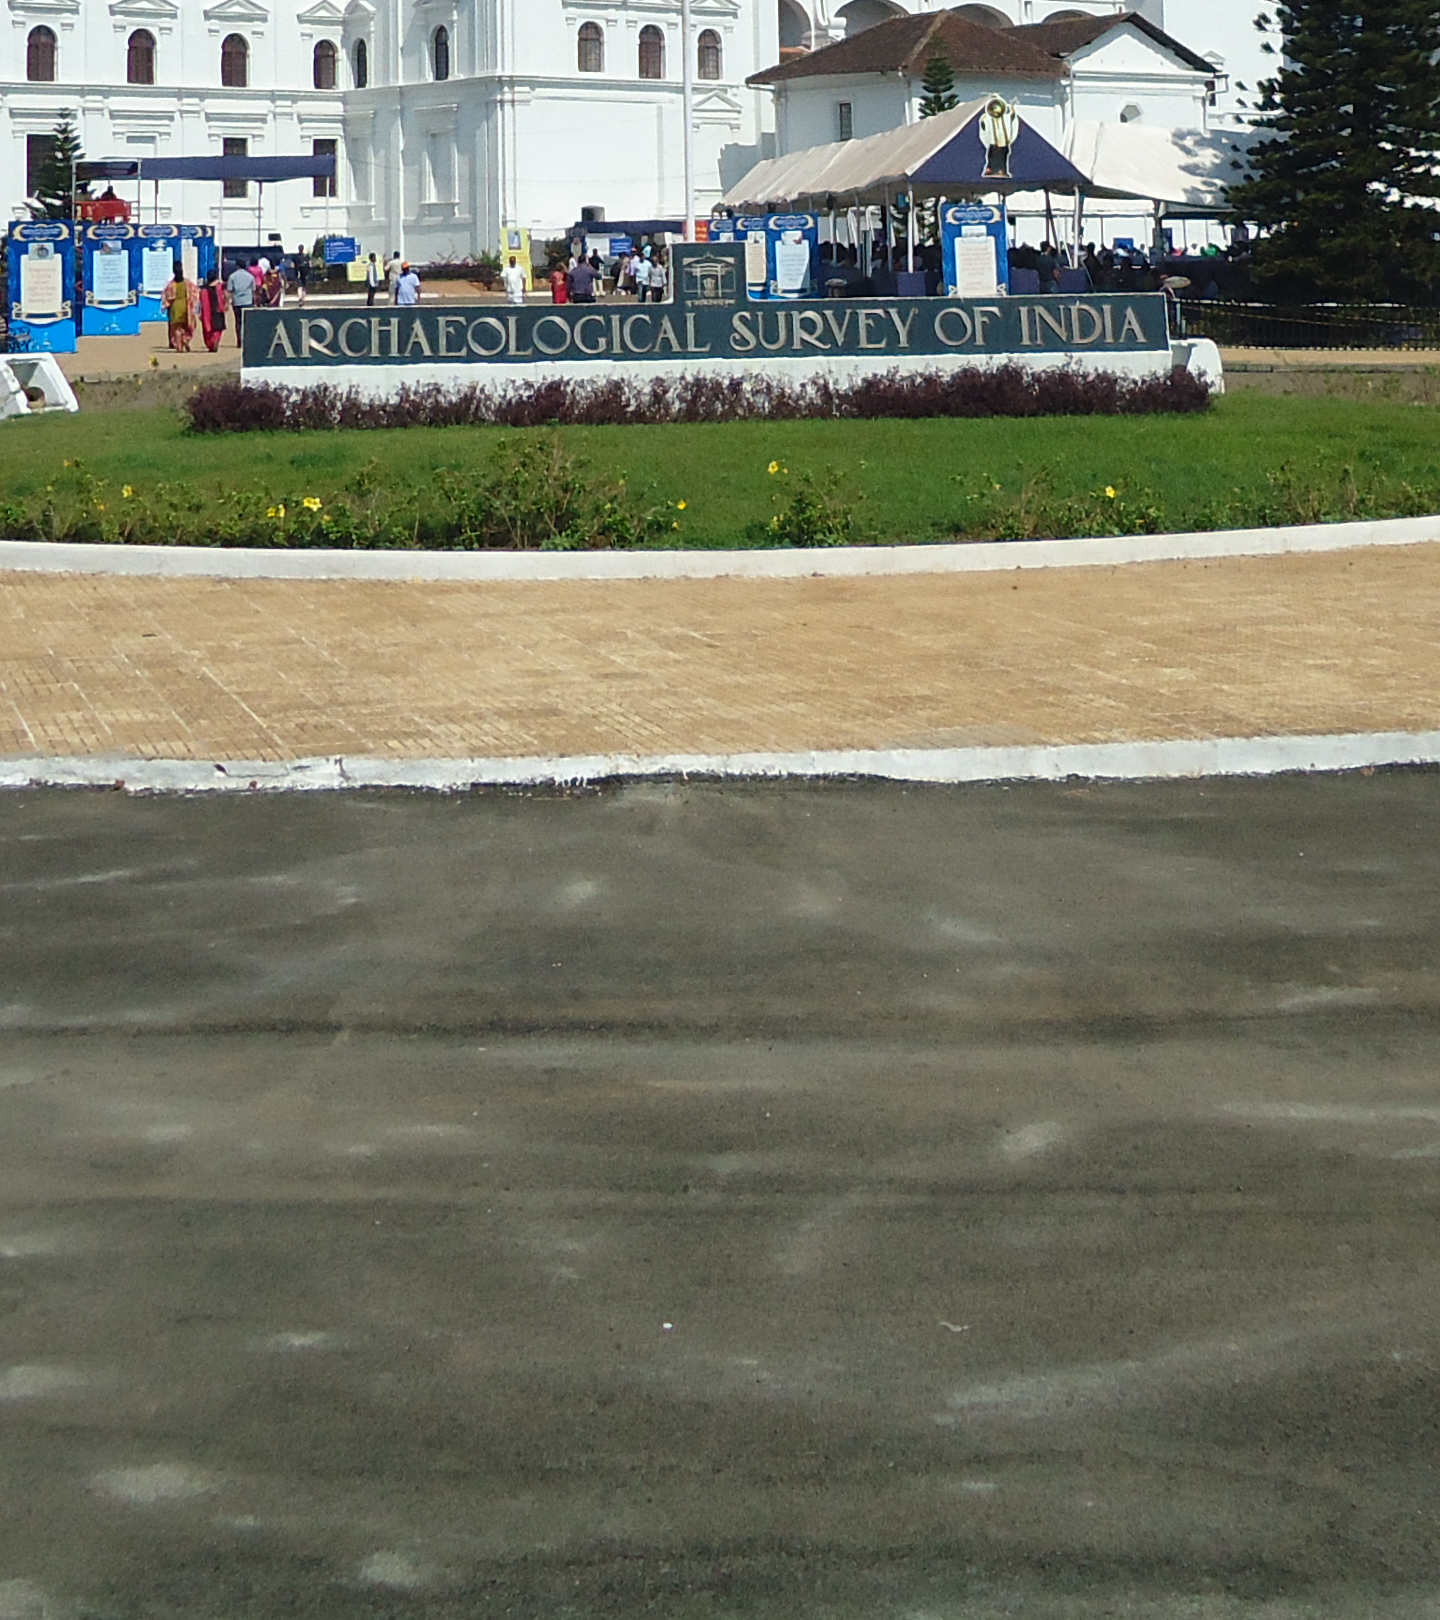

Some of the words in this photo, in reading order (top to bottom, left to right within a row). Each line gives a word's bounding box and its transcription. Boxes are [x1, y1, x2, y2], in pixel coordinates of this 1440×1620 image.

[266, 311, 711, 358] ARCHAEOLOGICAL
[729, 308, 918, 352] SURVEY
[934, 306, 1001, 346] OF
[1018, 304, 1147, 345] INDIA
